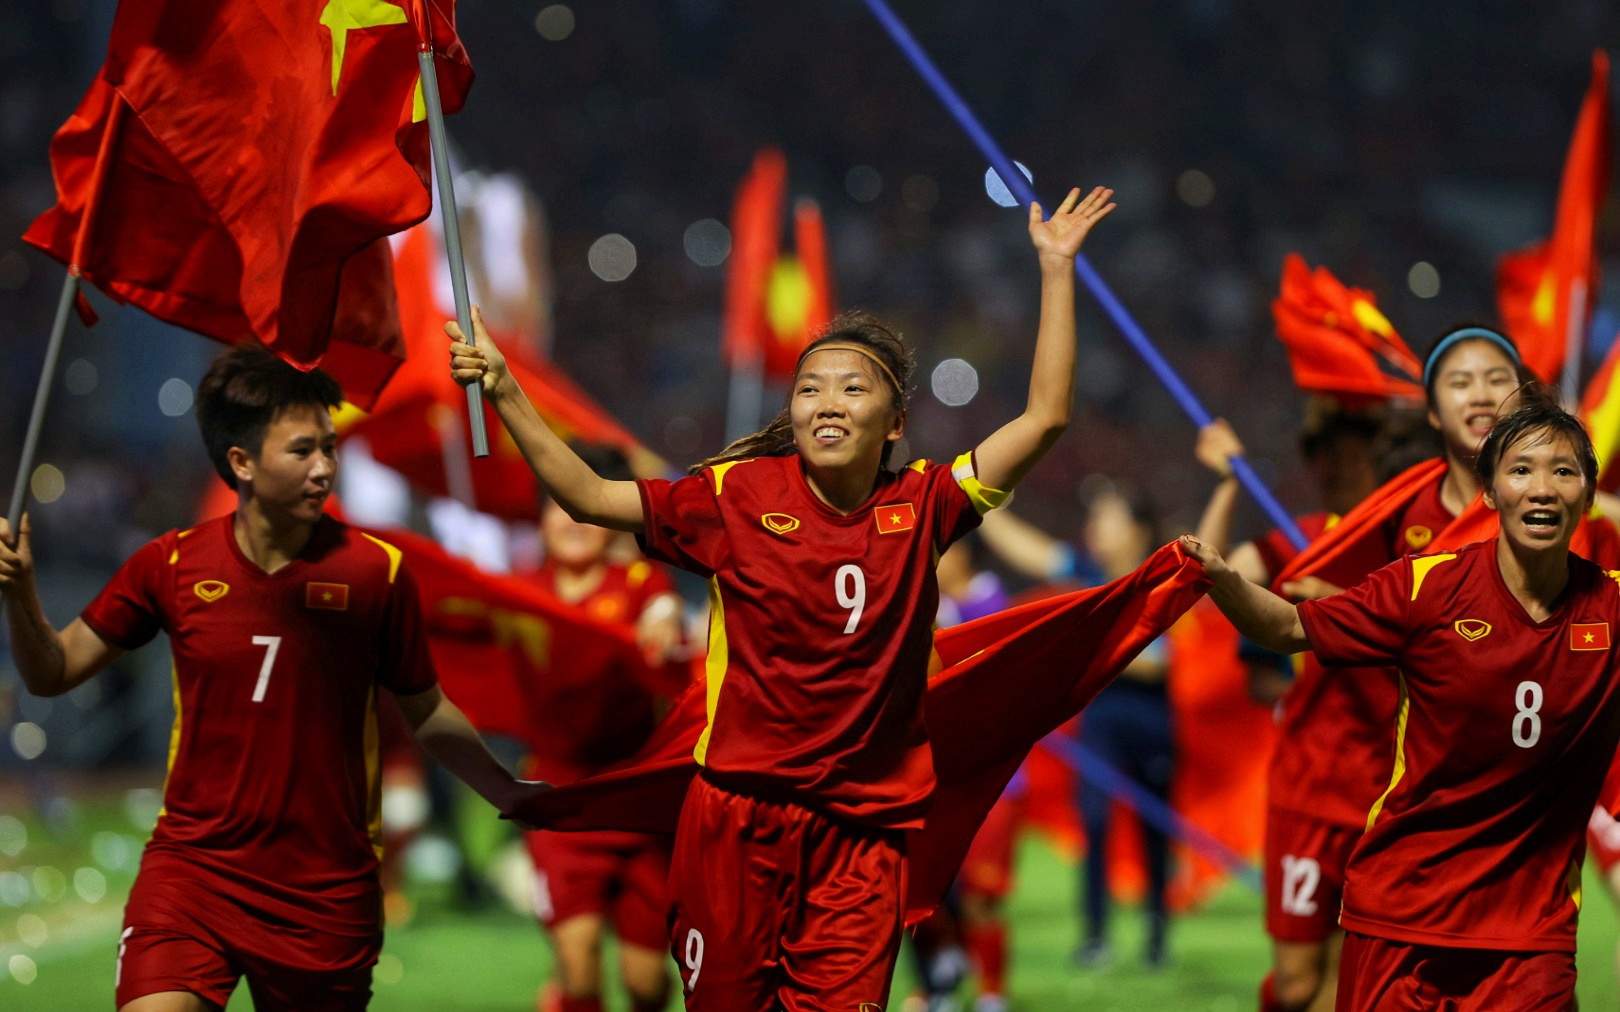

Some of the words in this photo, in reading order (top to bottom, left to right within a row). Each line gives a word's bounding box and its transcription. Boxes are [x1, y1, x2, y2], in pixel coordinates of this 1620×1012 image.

[835, 564, 866, 634] 9
[251, 635, 282, 702] 7
[1512, 680, 1543, 748] 8
[1281, 854, 1321, 916] 12
[685, 928, 704, 992] 9
